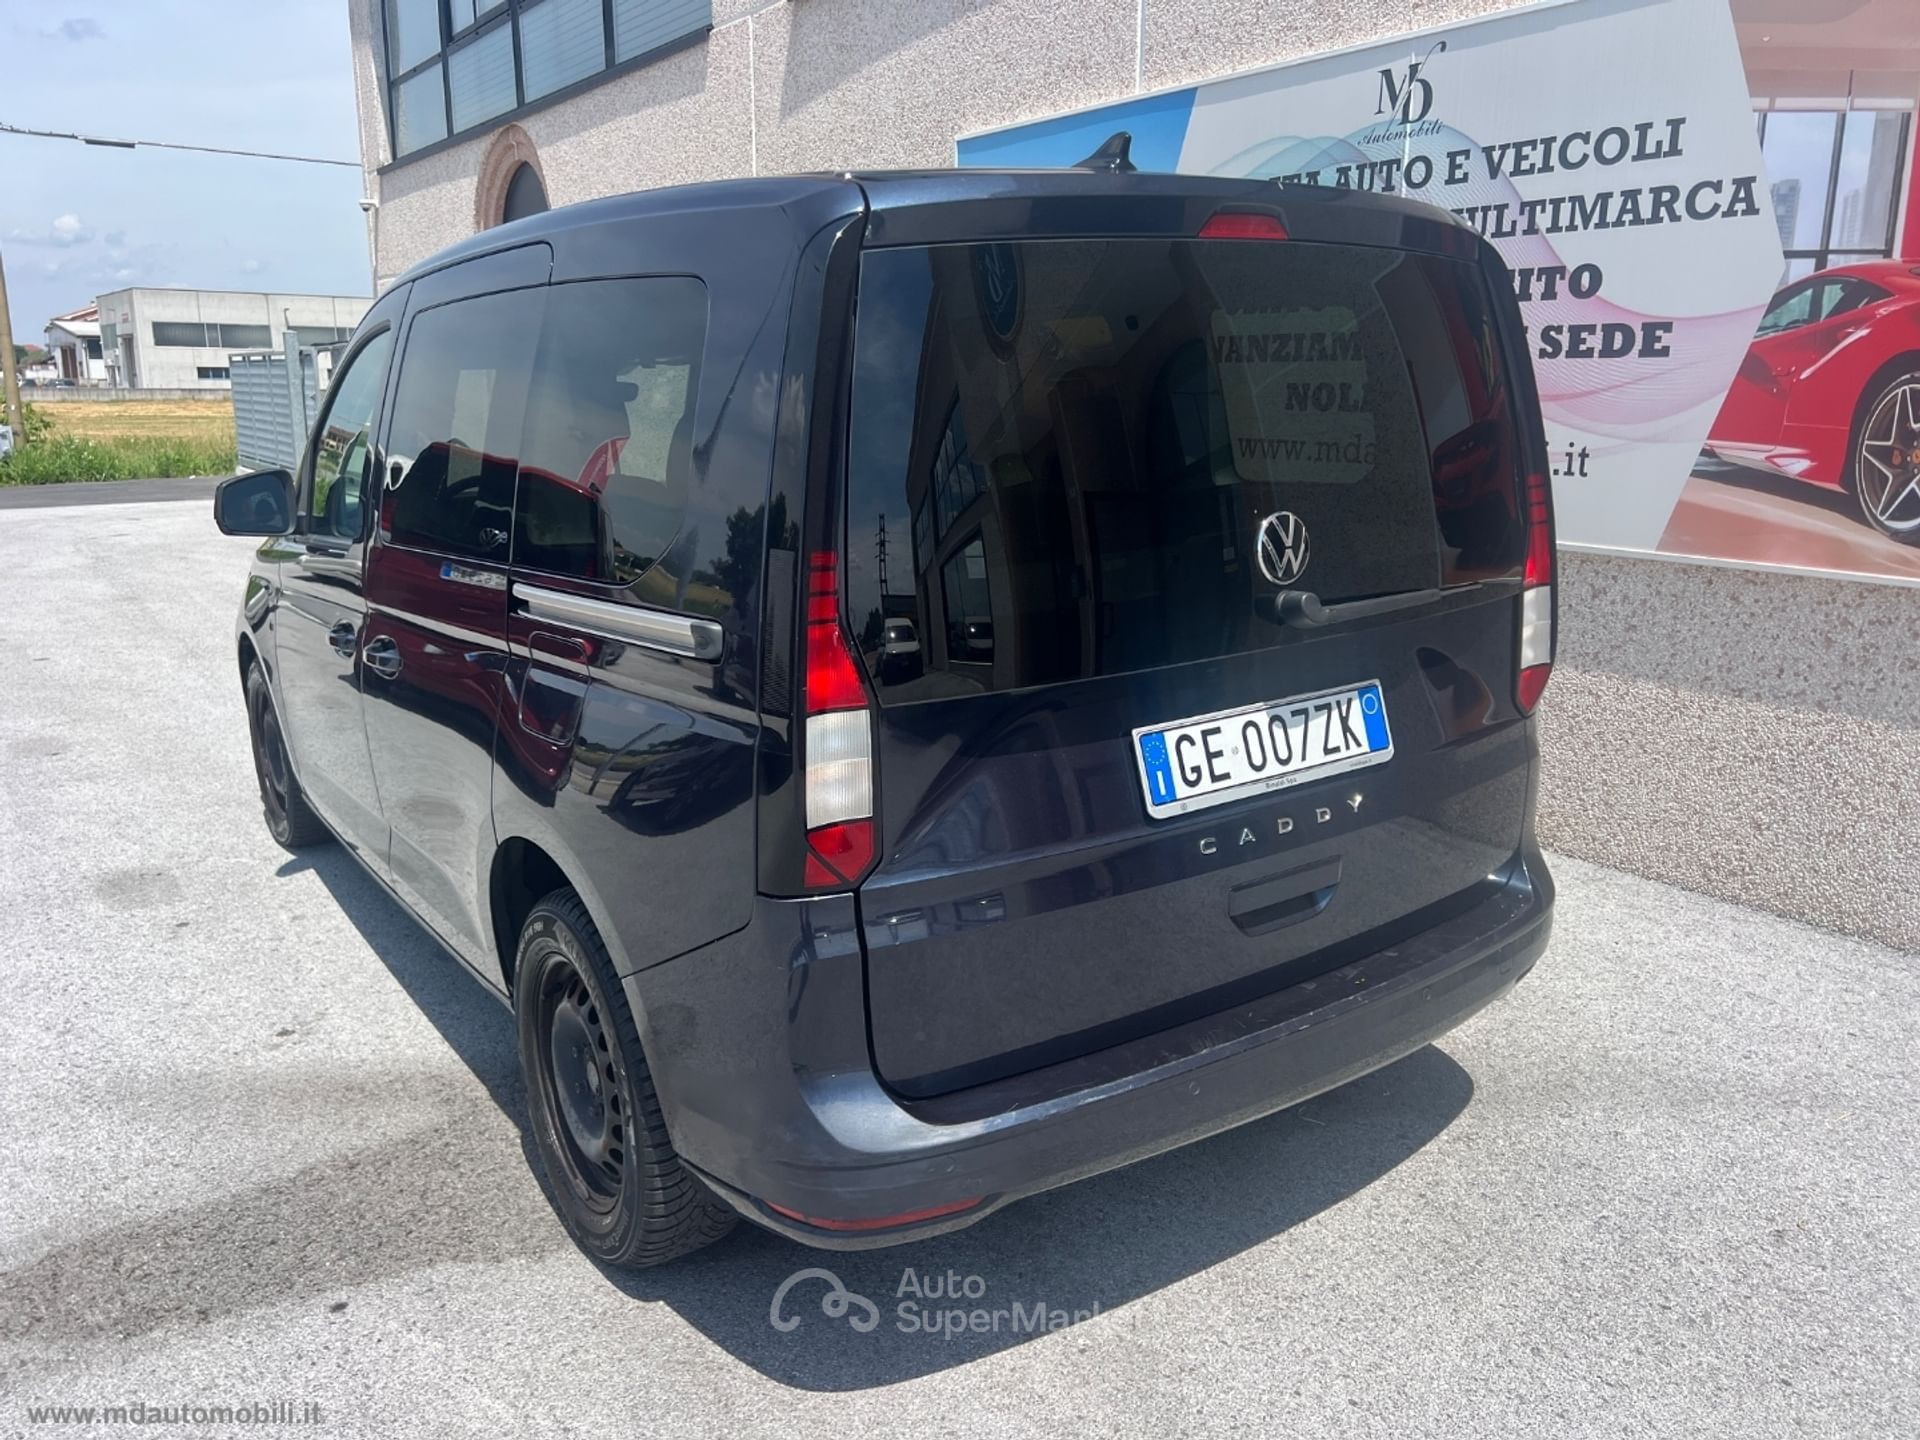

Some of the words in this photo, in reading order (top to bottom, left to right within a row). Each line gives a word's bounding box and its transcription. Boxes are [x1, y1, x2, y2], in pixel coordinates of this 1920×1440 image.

[1336, 154, 1433, 193] AUTO
[1444, 149, 1471, 186] E
[1481, 117, 1687, 180] VEICOLI
[1357, 118, 1443, 146] Automobili
[1450, 175, 1761, 239] ULTIMARCA
[1507, 263, 1603, 301] ITO
[1538, 321, 1674, 360] SEDE
[1174, 726, 1232, 788] GE
[1241, 697, 1363, 772] 007ZK
[1200, 792, 1363, 855] CADDY
